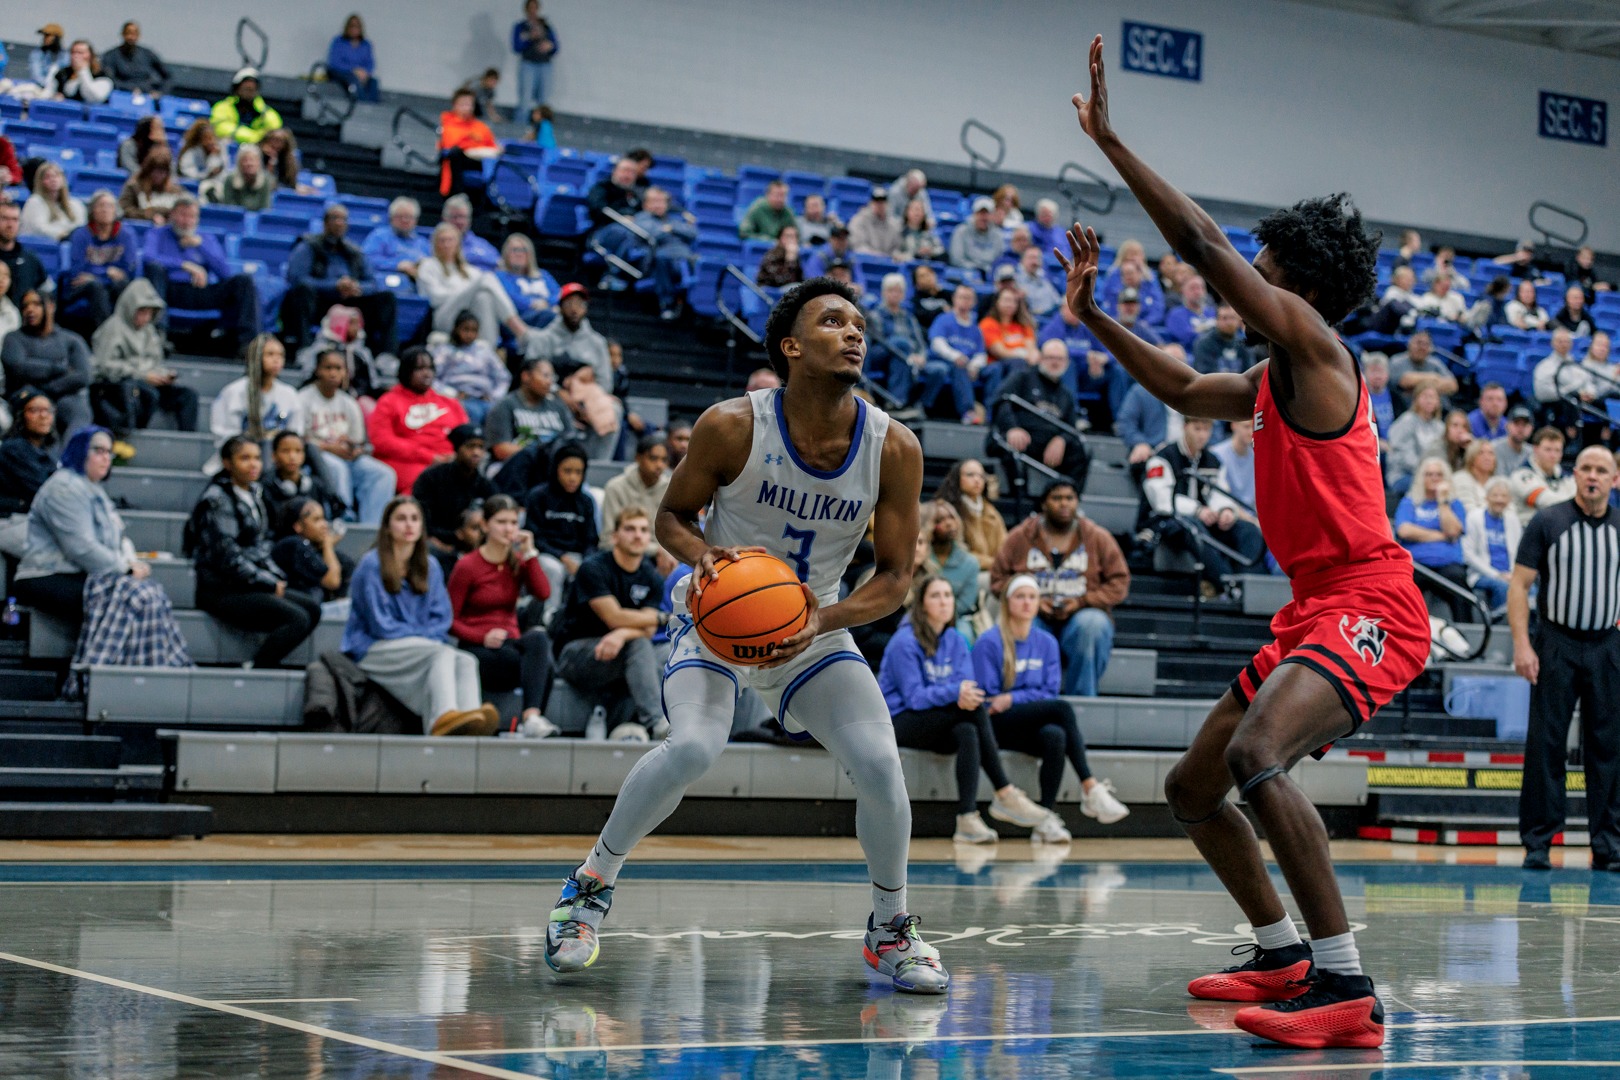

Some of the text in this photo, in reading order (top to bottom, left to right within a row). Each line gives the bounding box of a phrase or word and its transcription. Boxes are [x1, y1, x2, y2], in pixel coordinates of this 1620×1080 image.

[1127, 26, 1198, 77] SEC. 4
[1591, 104, 1603, 141] 5
[756, 480, 863, 522] MILLIKIN
[782, 522, 817, 585] 3
[732, 641, 789, 660] Wil
